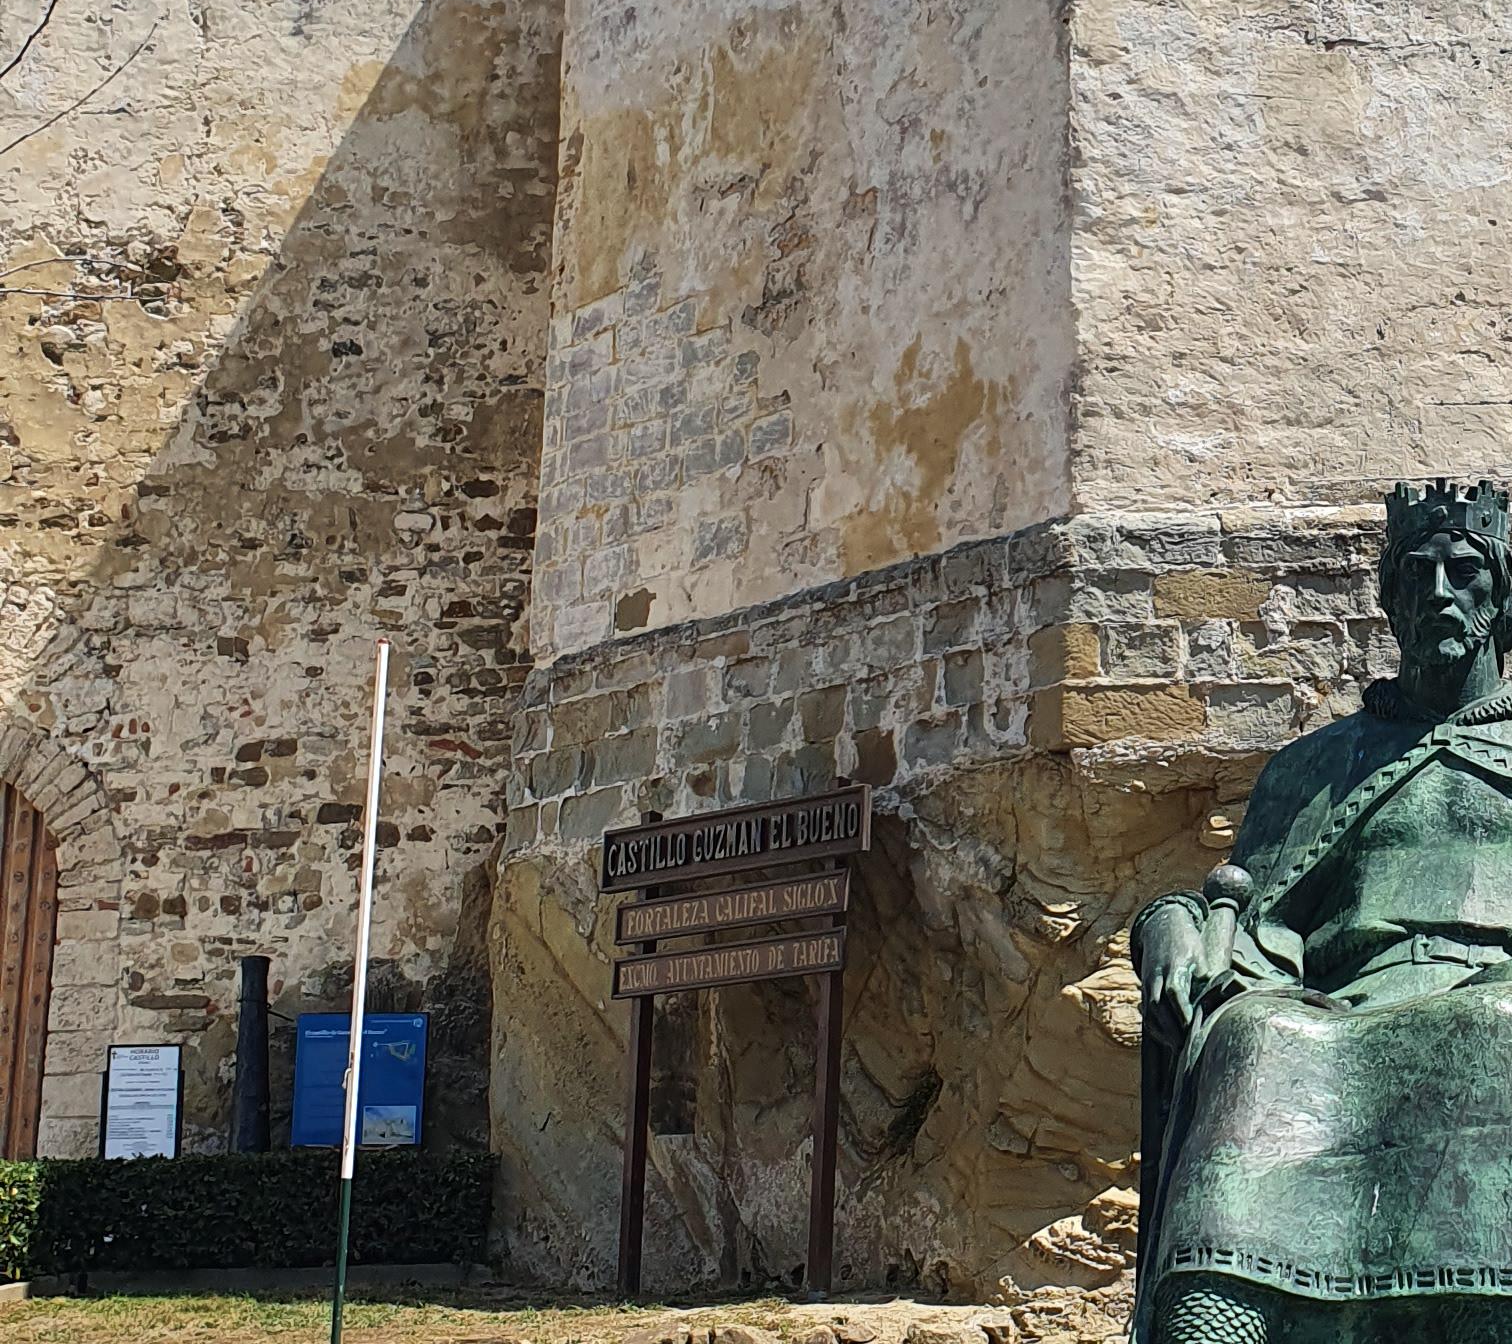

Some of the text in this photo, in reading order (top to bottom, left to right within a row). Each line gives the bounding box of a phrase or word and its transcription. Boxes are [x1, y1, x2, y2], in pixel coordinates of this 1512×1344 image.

[608, 804, 858, 876] CASTILLO GUZMAN EL BUENO
[627, 879, 838, 936] FORTALEZA CALIFAL SIGLO X
[666, 949, 760, 984] AYUNTAMIENTO
[768, 944, 785, 971] DE
